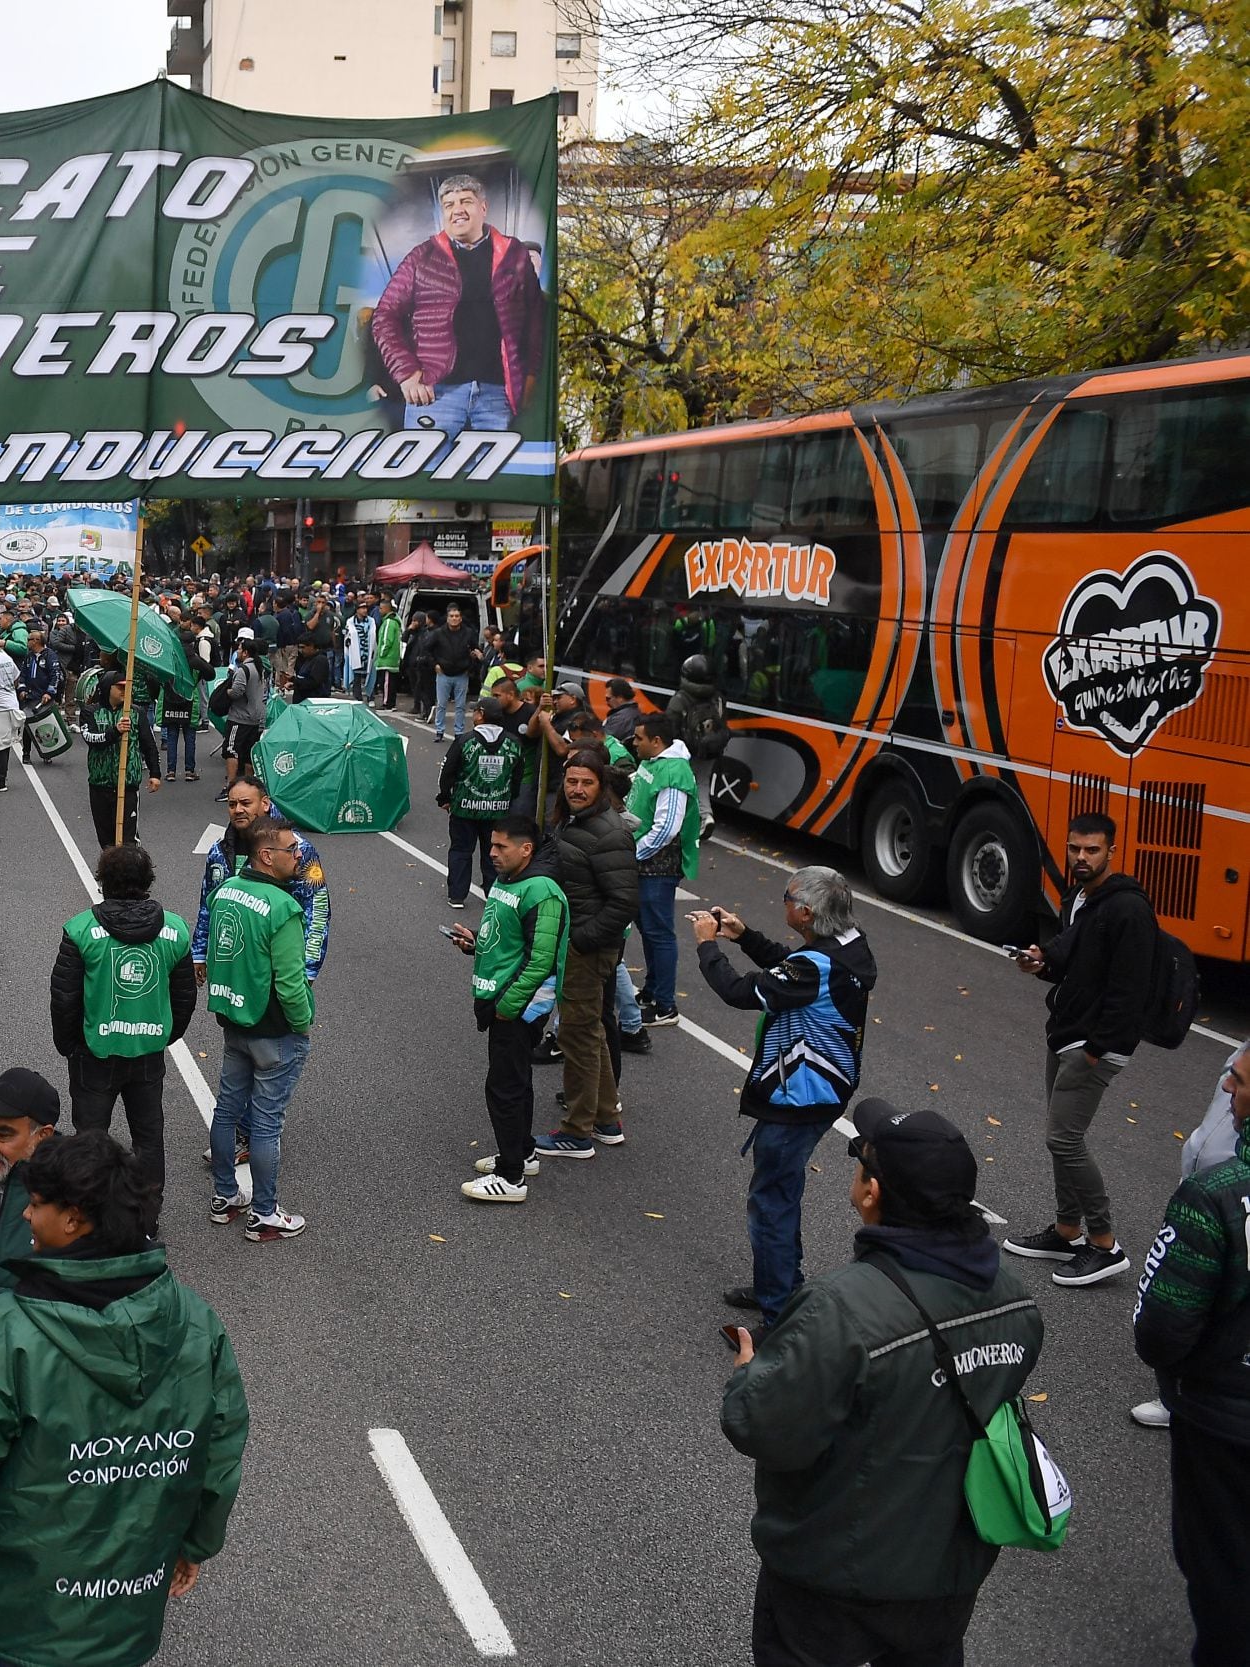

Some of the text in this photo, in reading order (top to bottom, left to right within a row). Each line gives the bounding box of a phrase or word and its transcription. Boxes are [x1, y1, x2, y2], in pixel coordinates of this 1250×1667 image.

[41, 554, 133, 576] EZEIZA
[684, 536, 836, 606] EXPERTUR
[1048, 610, 1210, 691] EXPERTUR
[931, 1343, 1025, 1387] CMIONEROS
[69, 1430, 195, 1461] MOYANO
[67, 1454, 190, 1485] CONDUCCIÓN
[55, 1562, 166, 1599] CAMIONEROS
